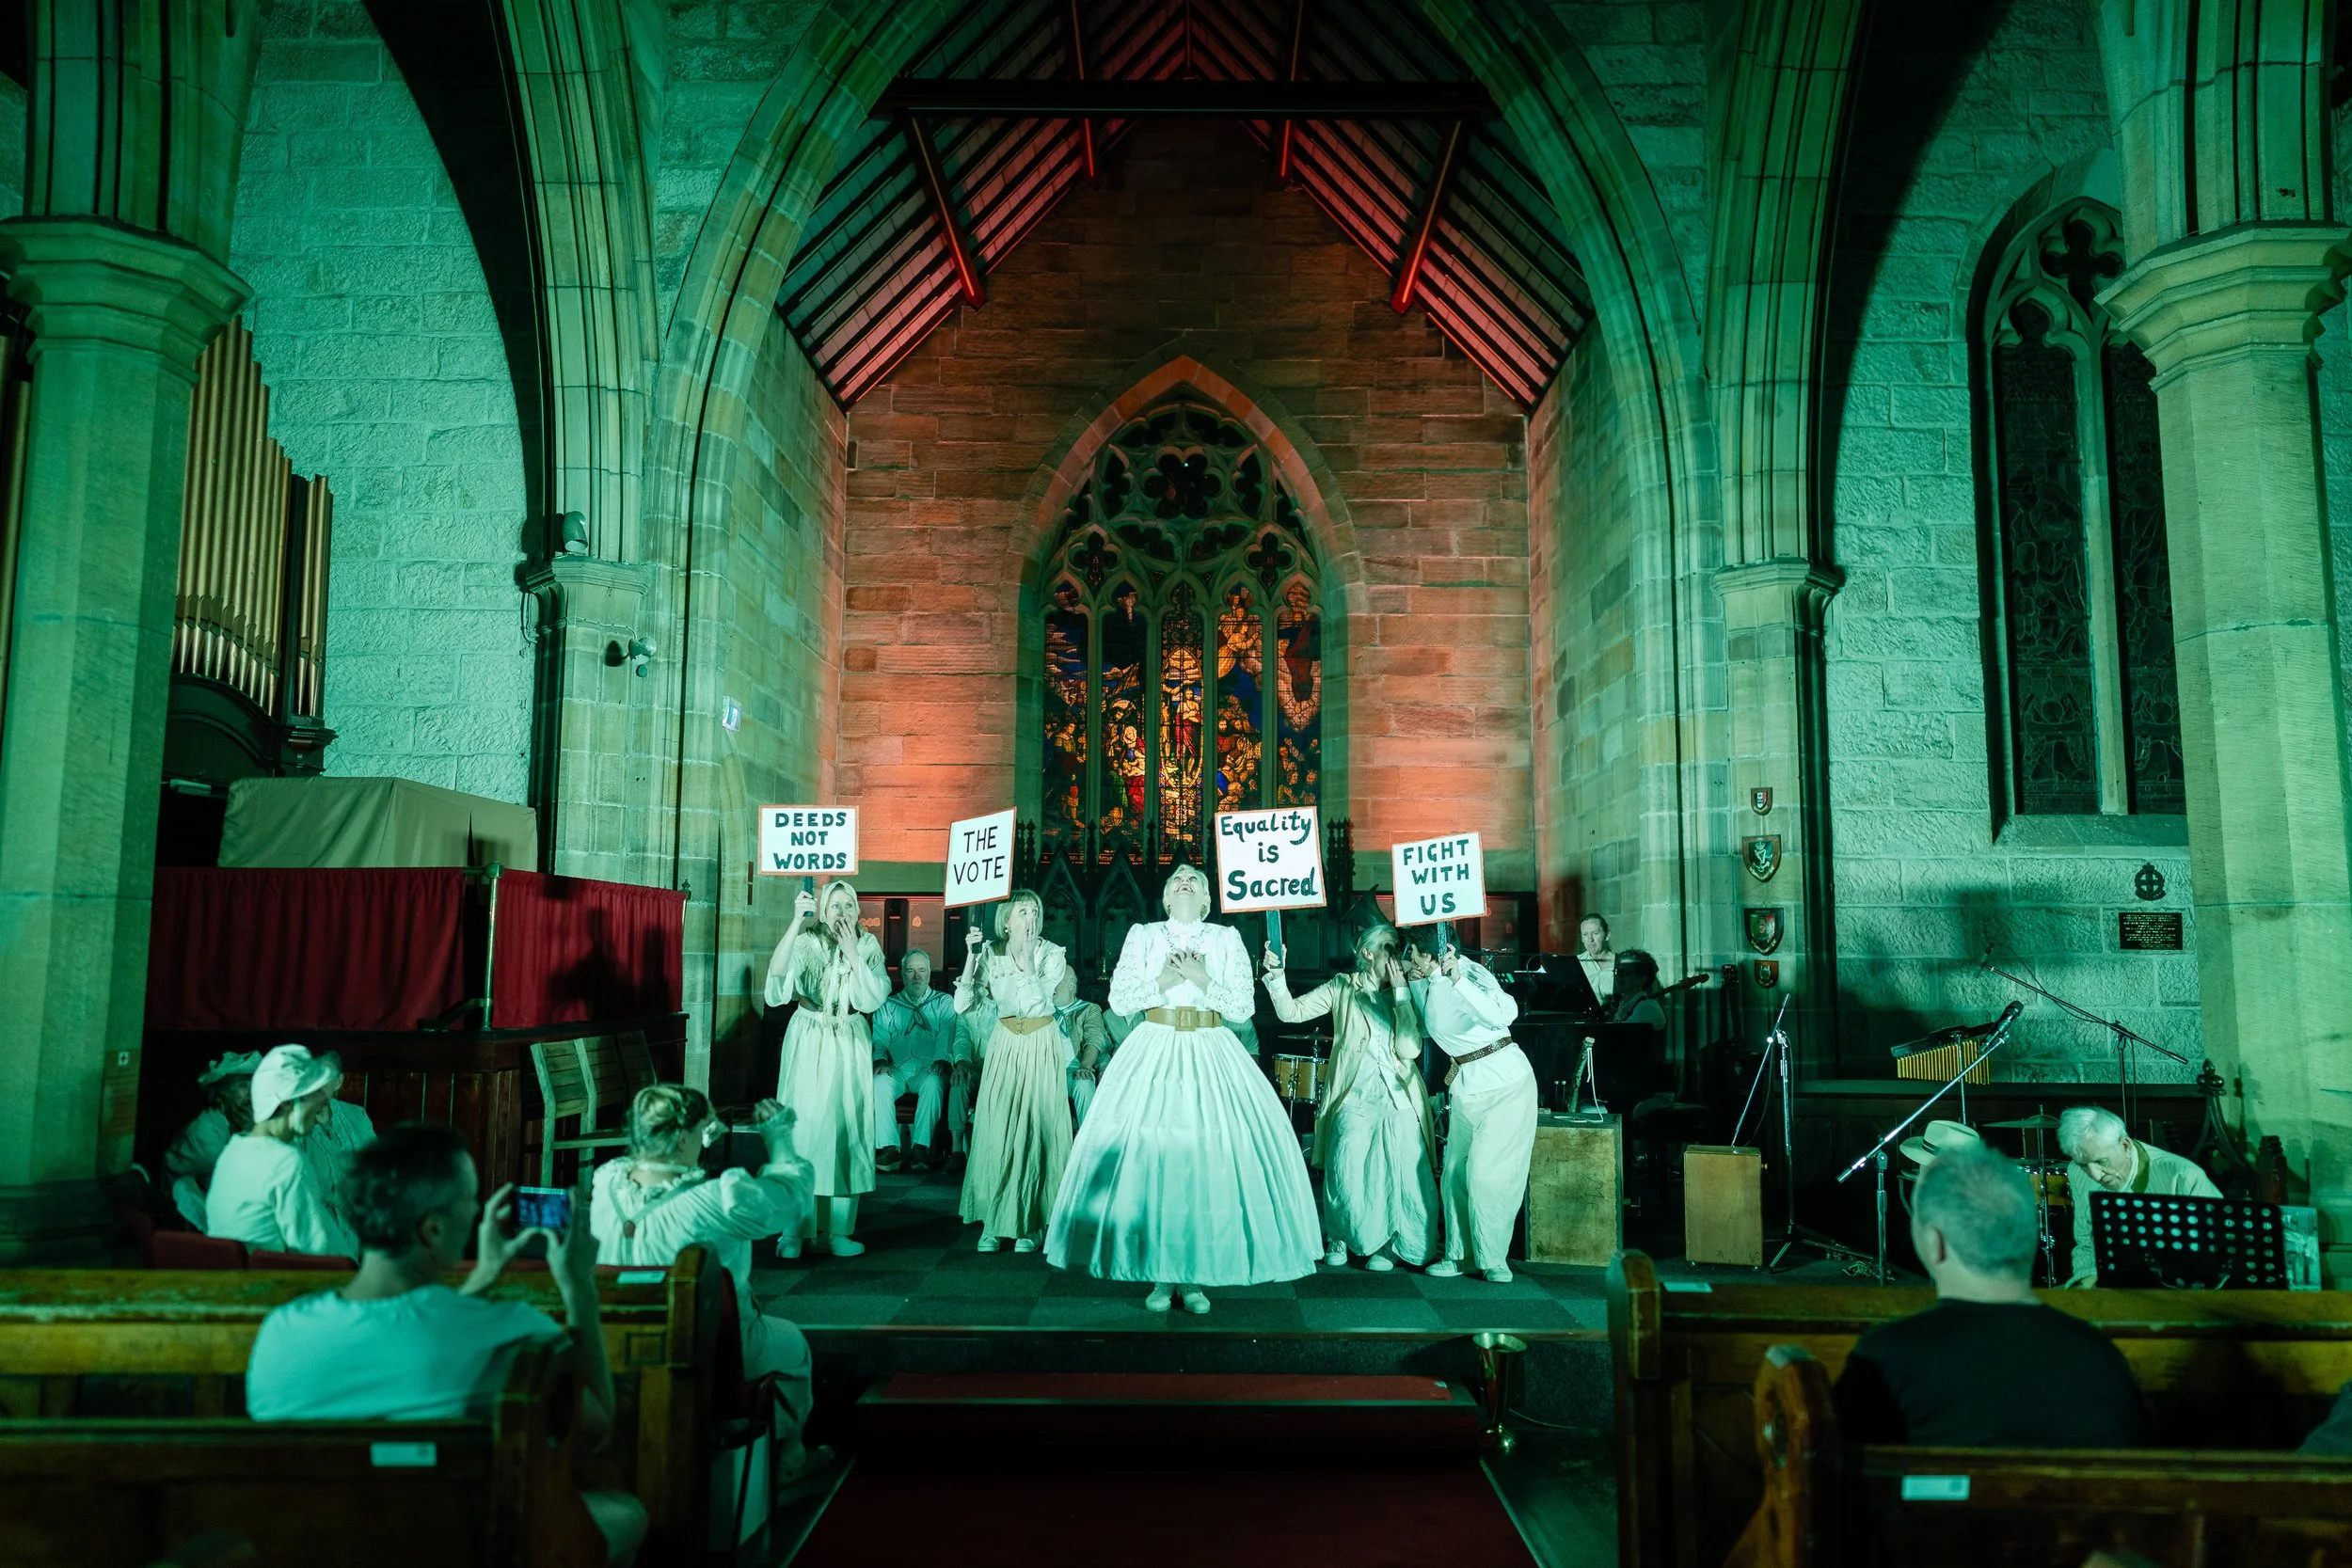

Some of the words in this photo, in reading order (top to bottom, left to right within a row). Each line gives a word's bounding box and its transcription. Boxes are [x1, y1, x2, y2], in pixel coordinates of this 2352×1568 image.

[775, 812, 847, 828] DEEDS
[1220, 810, 1312, 846] Equality
[790, 830, 829, 847] NOT
[963, 825, 998, 853] THE
[772, 851, 847, 870] WORDS
[1258, 841, 1279, 863] is
[1403, 838, 1470, 866] FIGHT
[953, 855, 1006, 885] VOTE
[1411, 863, 1470, 885] WITH
[1226, 866, 1319, 901] Sacred
[1420, 892, 1456, 916] US
